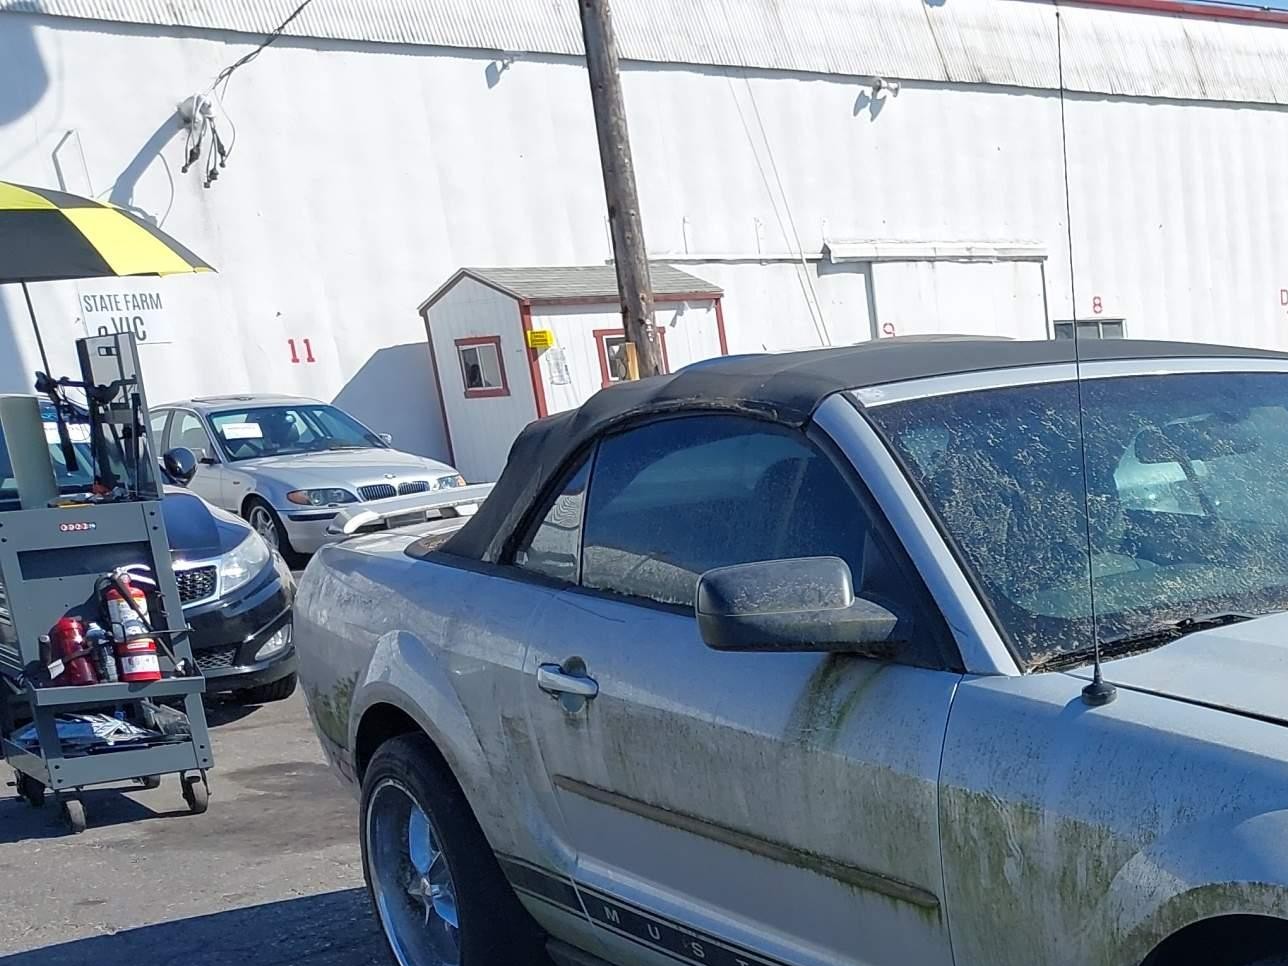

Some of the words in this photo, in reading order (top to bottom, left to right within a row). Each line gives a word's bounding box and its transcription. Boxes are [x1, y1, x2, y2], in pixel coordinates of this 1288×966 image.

[83, 294, 123, 312] STATE
[123, 292, 163, 311] FARM
[1092, 296, 1103, 315] 8
[288, 339, 315, 363] 11
